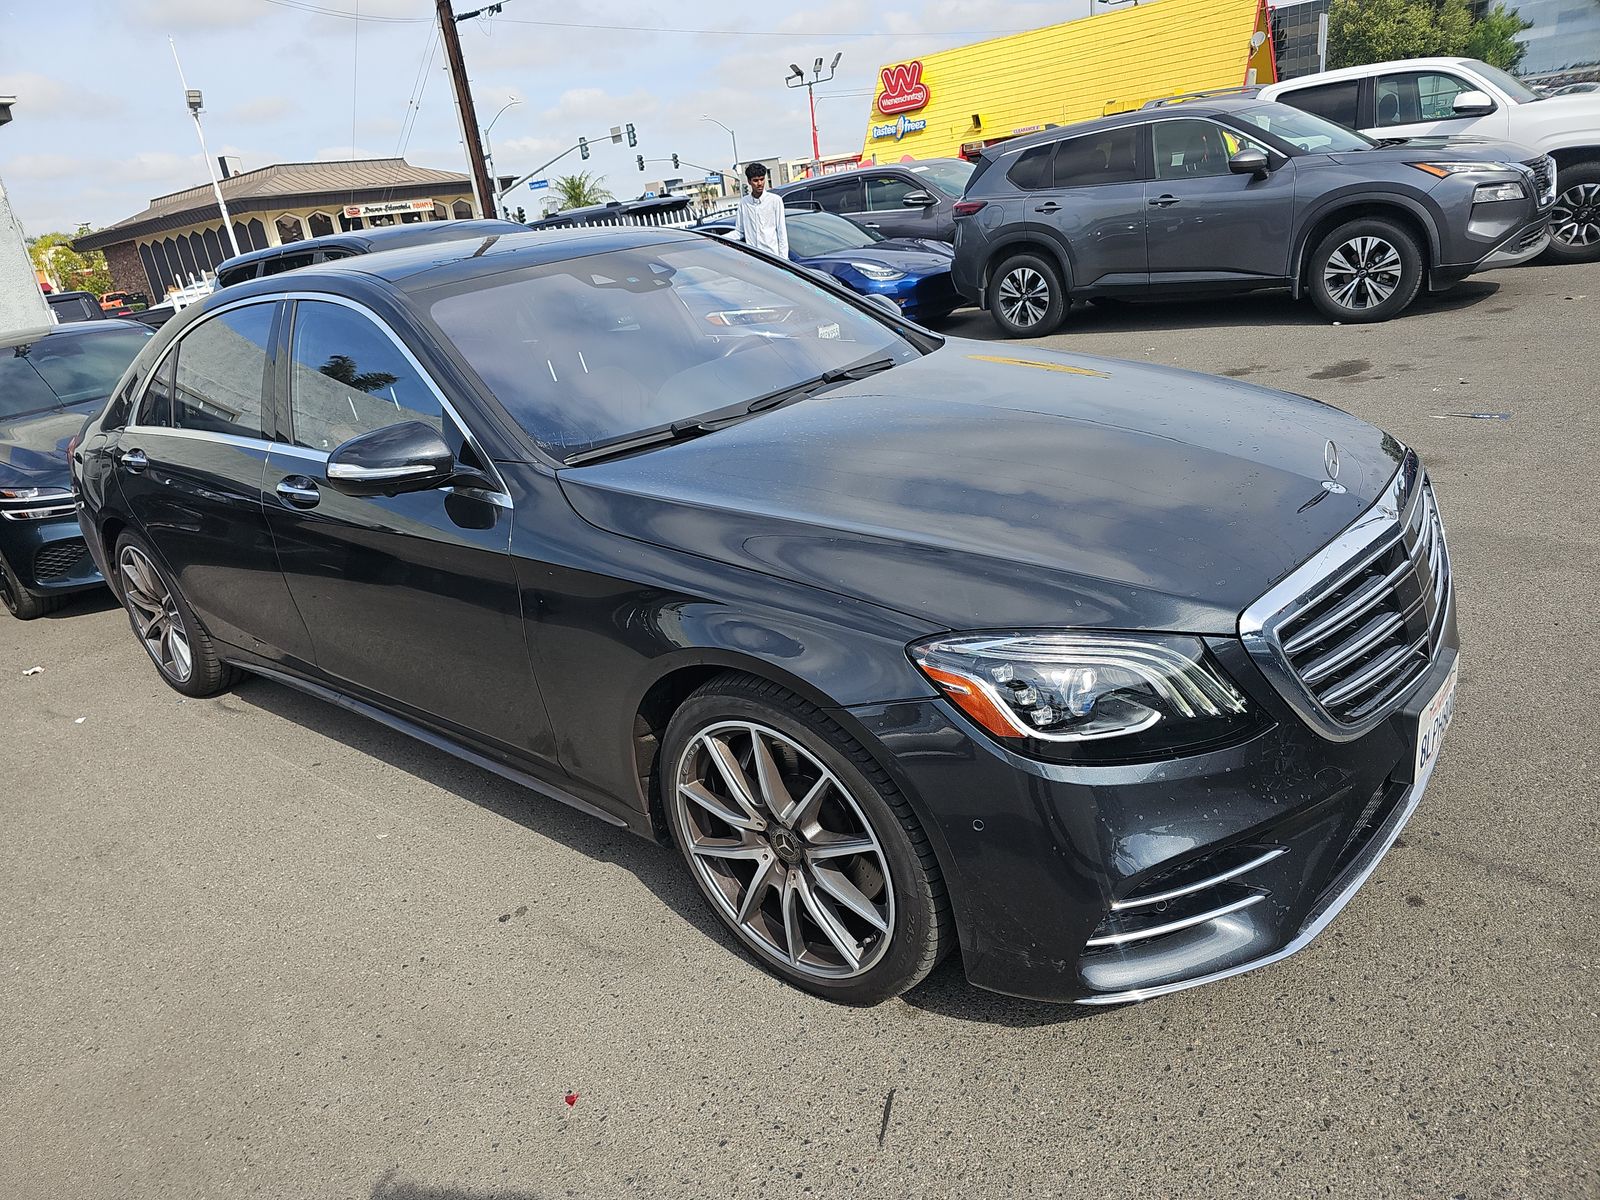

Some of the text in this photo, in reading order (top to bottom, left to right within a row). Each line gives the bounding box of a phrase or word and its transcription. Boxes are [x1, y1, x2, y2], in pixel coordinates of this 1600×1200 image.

[882, 91, 924, 106] Wienerschnitzel
[873, 119, 926, 138] tastee freez
